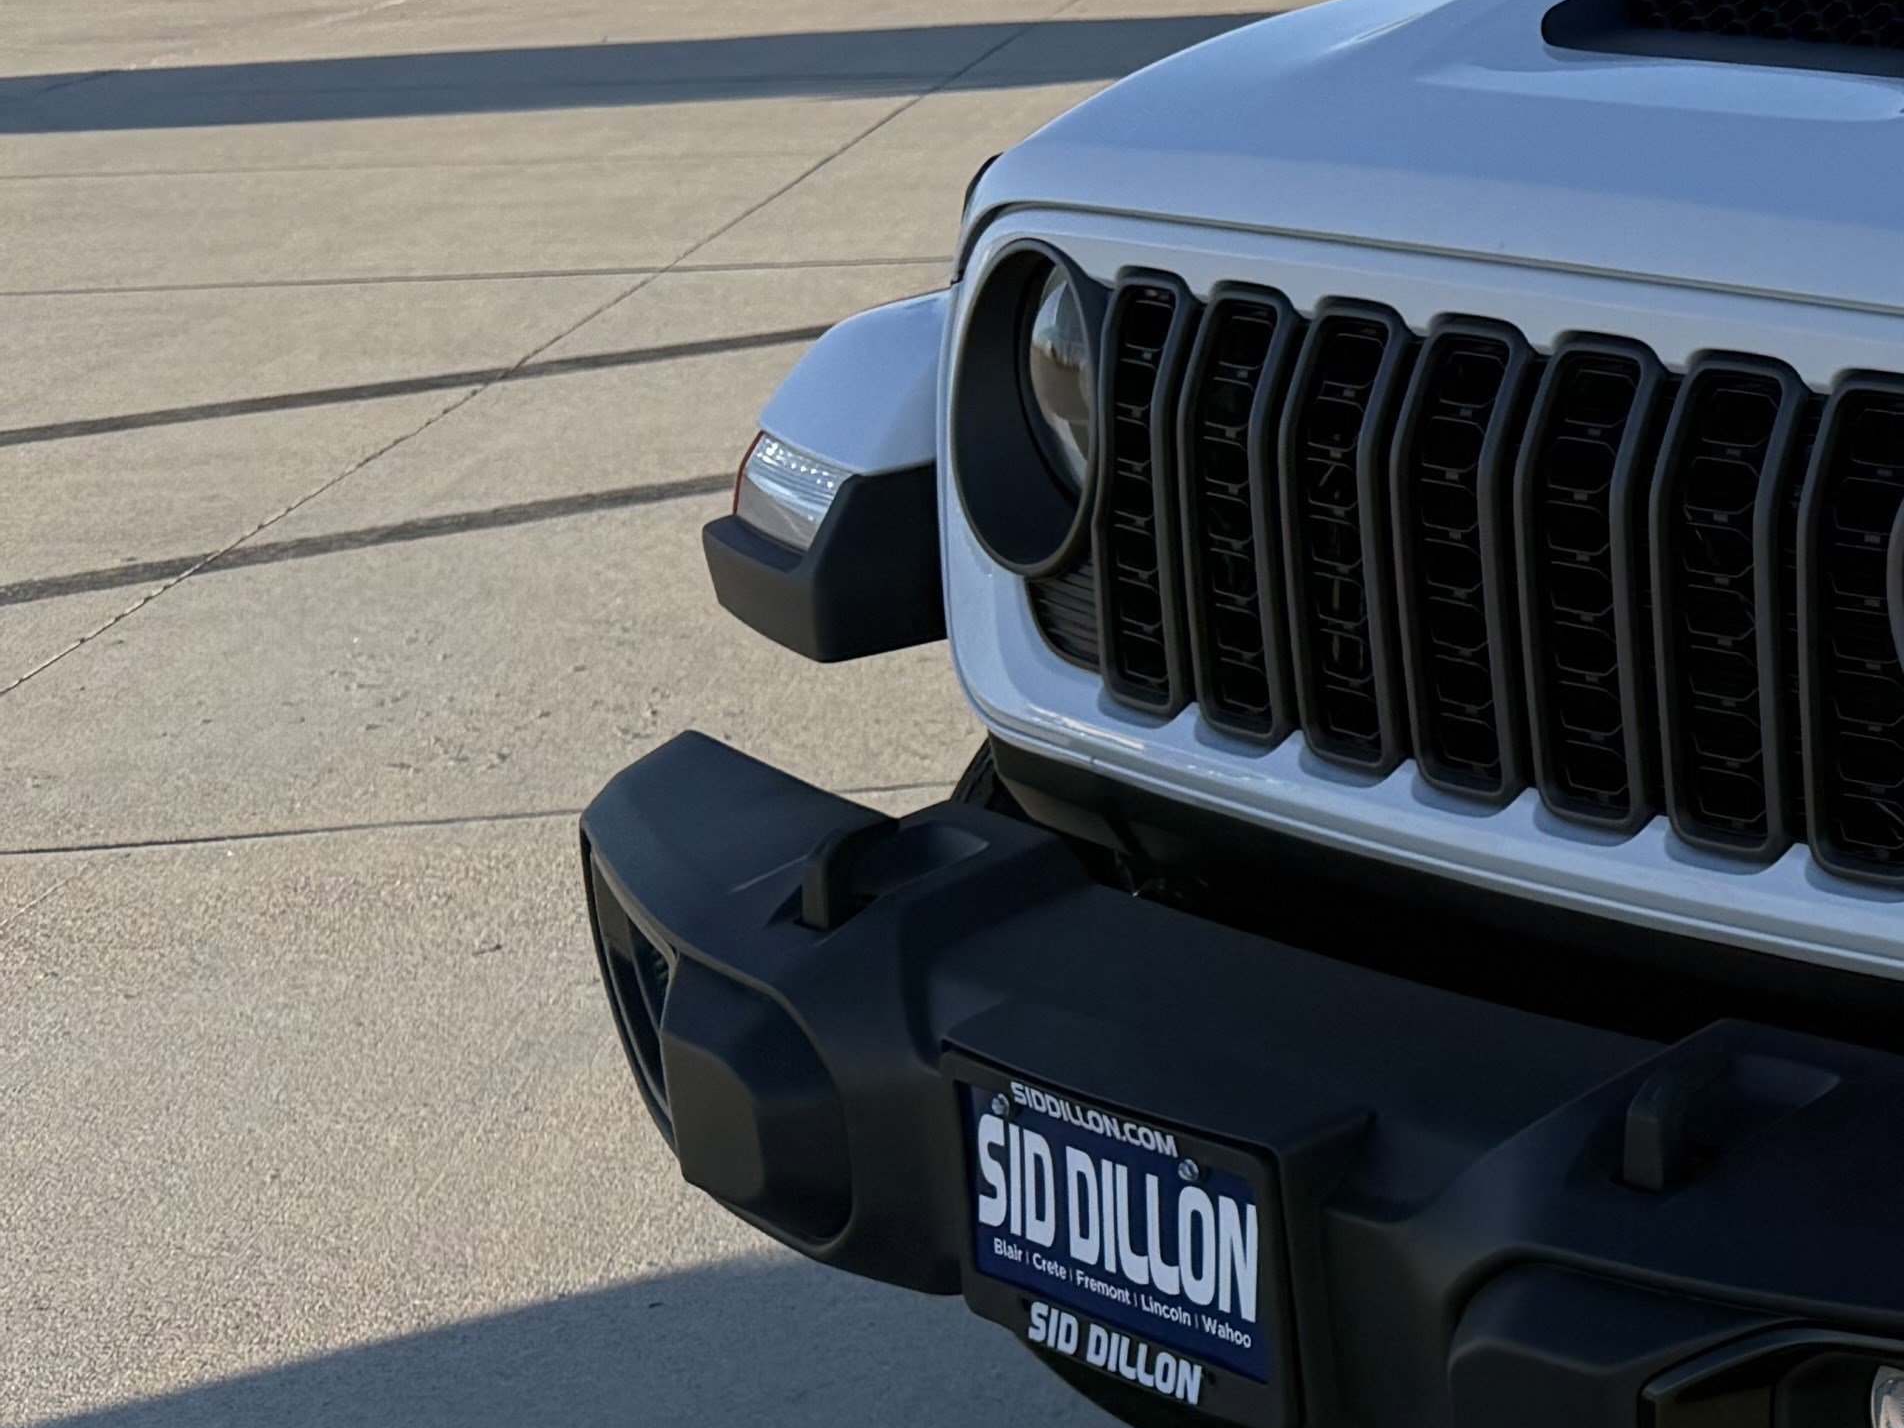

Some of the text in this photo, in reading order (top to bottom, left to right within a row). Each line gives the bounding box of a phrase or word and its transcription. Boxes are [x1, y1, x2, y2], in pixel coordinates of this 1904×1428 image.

[1010, 1080, 1179, 1158] SIDDILLON.COM
[977, 1112, 1259, 1323] SID DILLON
[993, 1237, 1252, 1349] Blair Crete Fremont Lincoln Wahoo
[1028, 1301, 1203, 1406] SID DILLON
